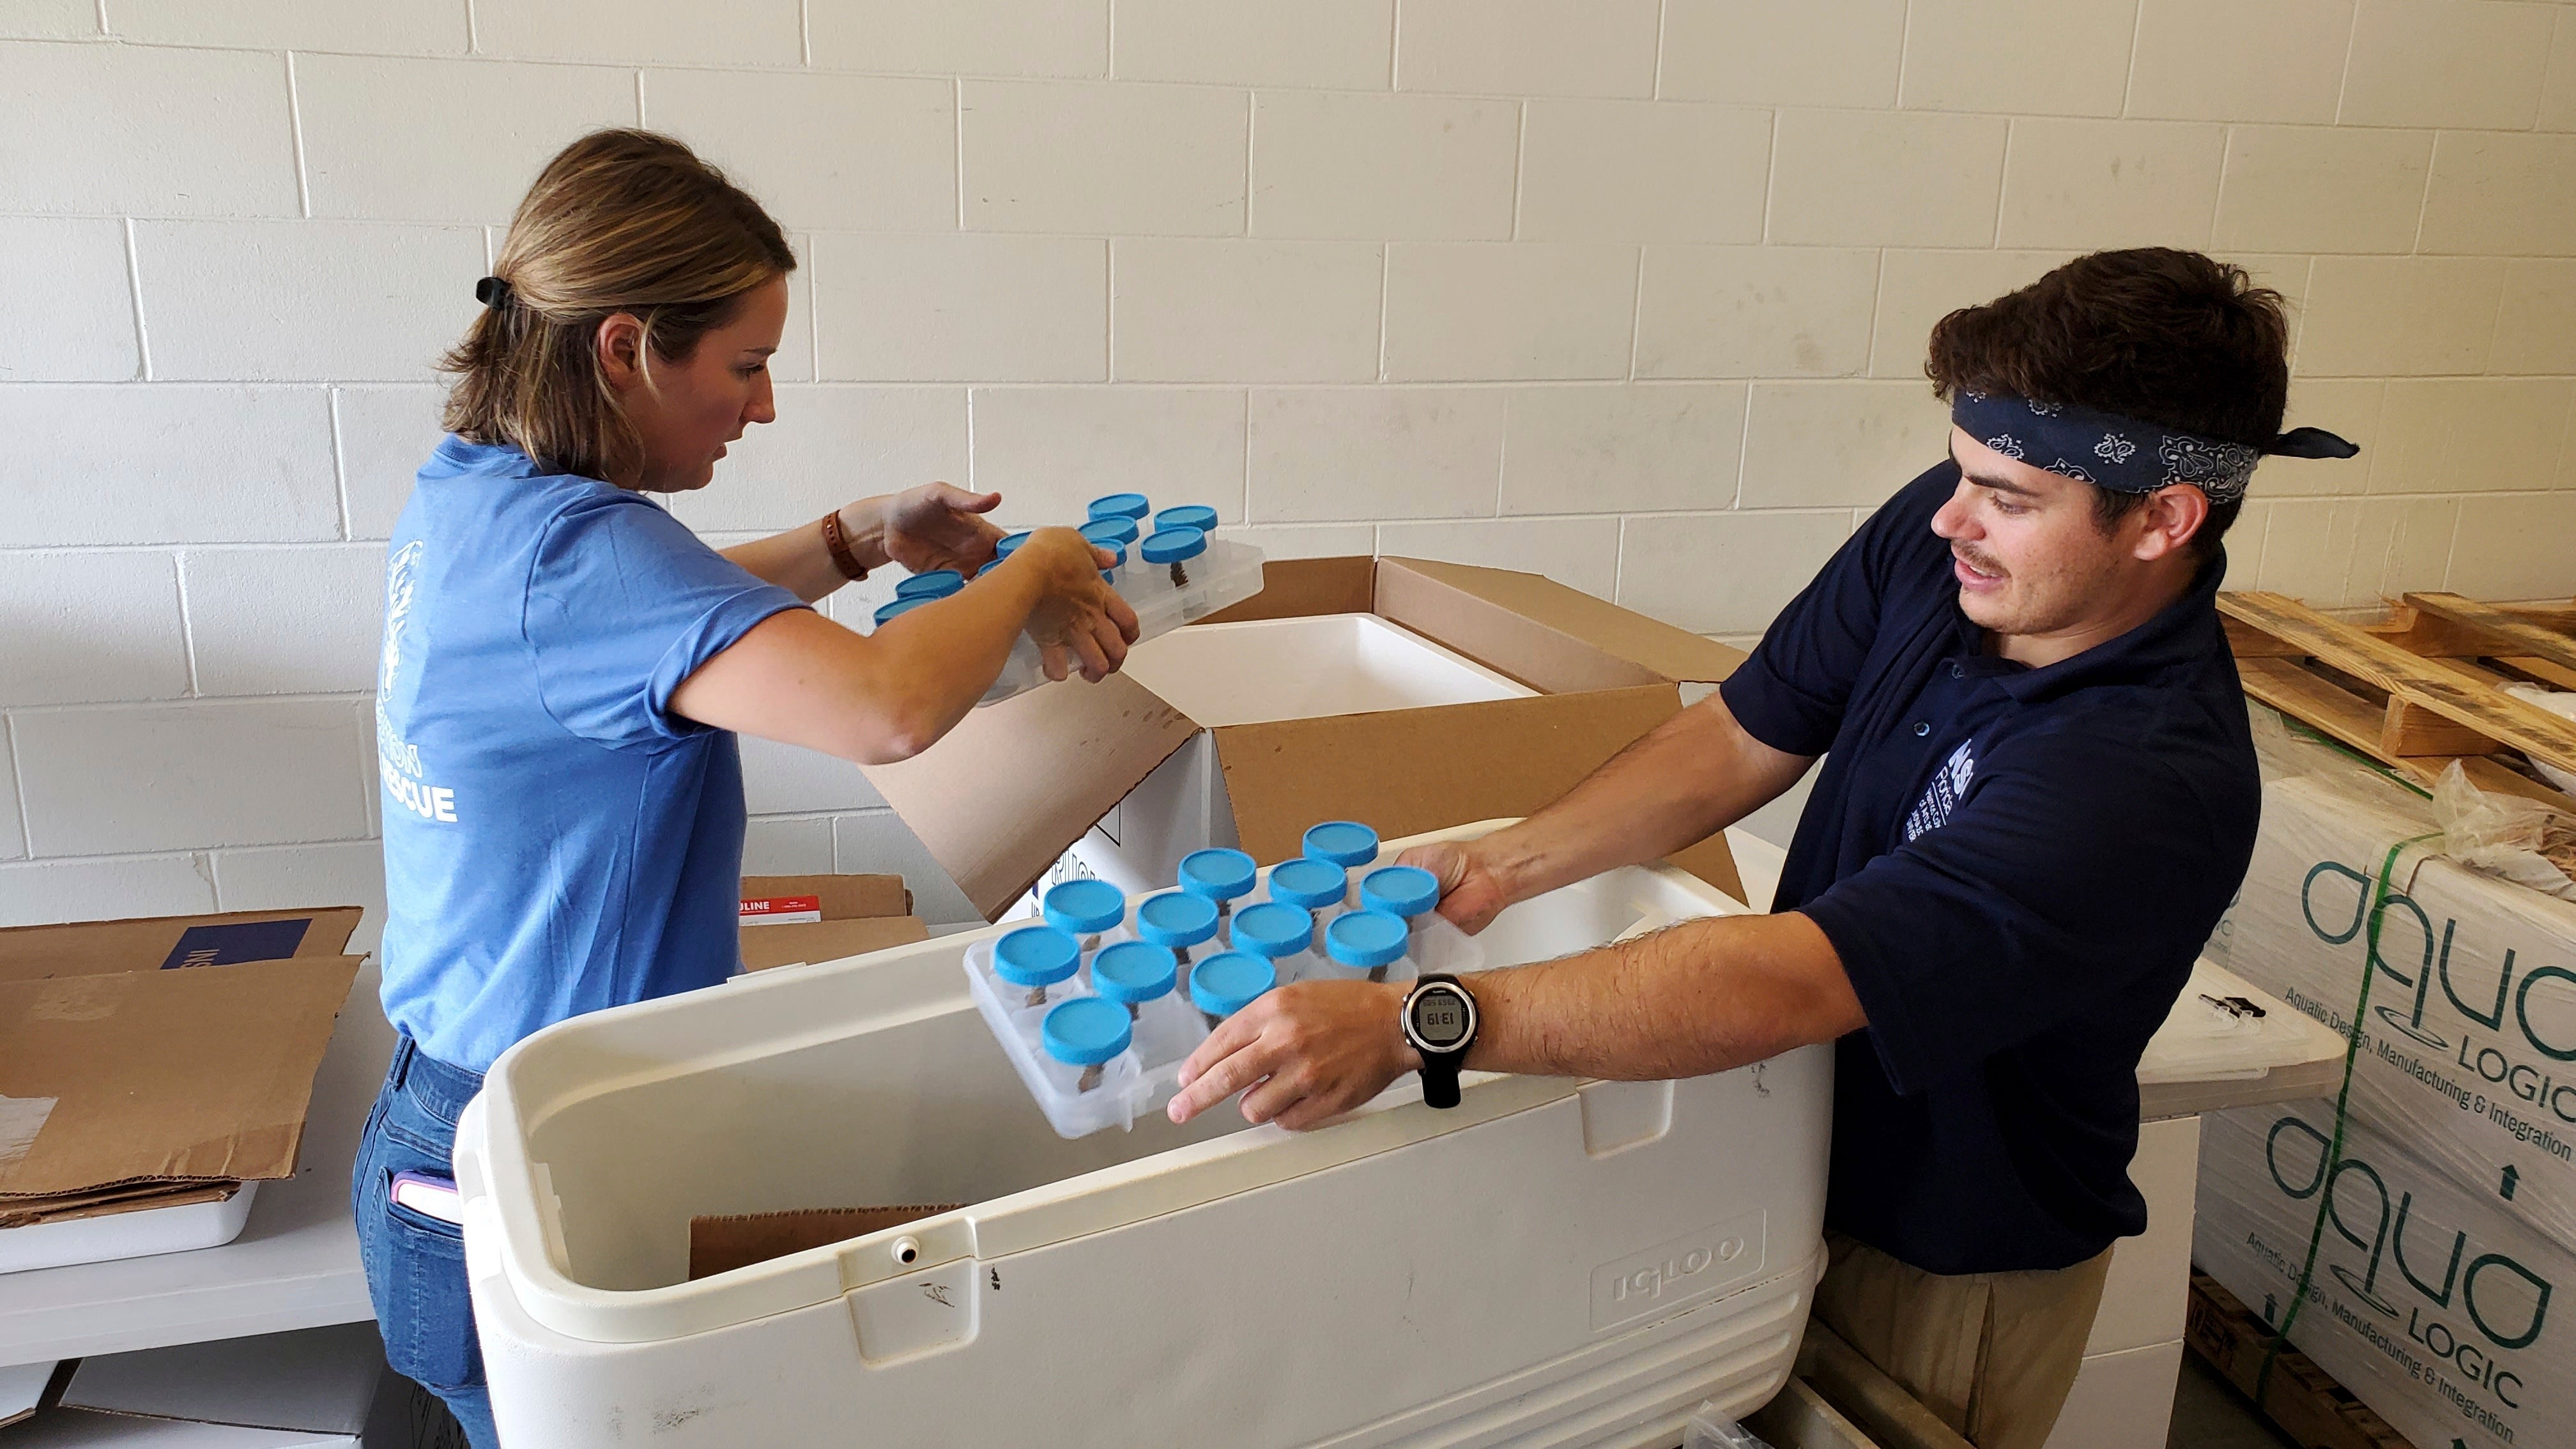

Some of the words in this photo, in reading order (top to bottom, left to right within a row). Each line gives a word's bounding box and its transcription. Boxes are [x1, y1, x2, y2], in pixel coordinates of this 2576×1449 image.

[2285, 987, 2328, 1023] Aquatic
[2330, 1011, 2373, 1053] Desgn,
[2377, 1044, 2472, 1111] Manufacturing
[2474, 1096, 2487, 1114] &
[2489, 1102, 2571, 1162] Integration
[2246, 1232, 2285, 1273] Aquatic
[2287, 1263, 2329, 1311] Deign,
[2333, 1298, 2421, 1380] Manufacturing
[2425, 1366, 2435, 1386] &
[2439, 1376, 2515, 1444] Integration
[2408, 1307, 2524, 1409] LOGIC
